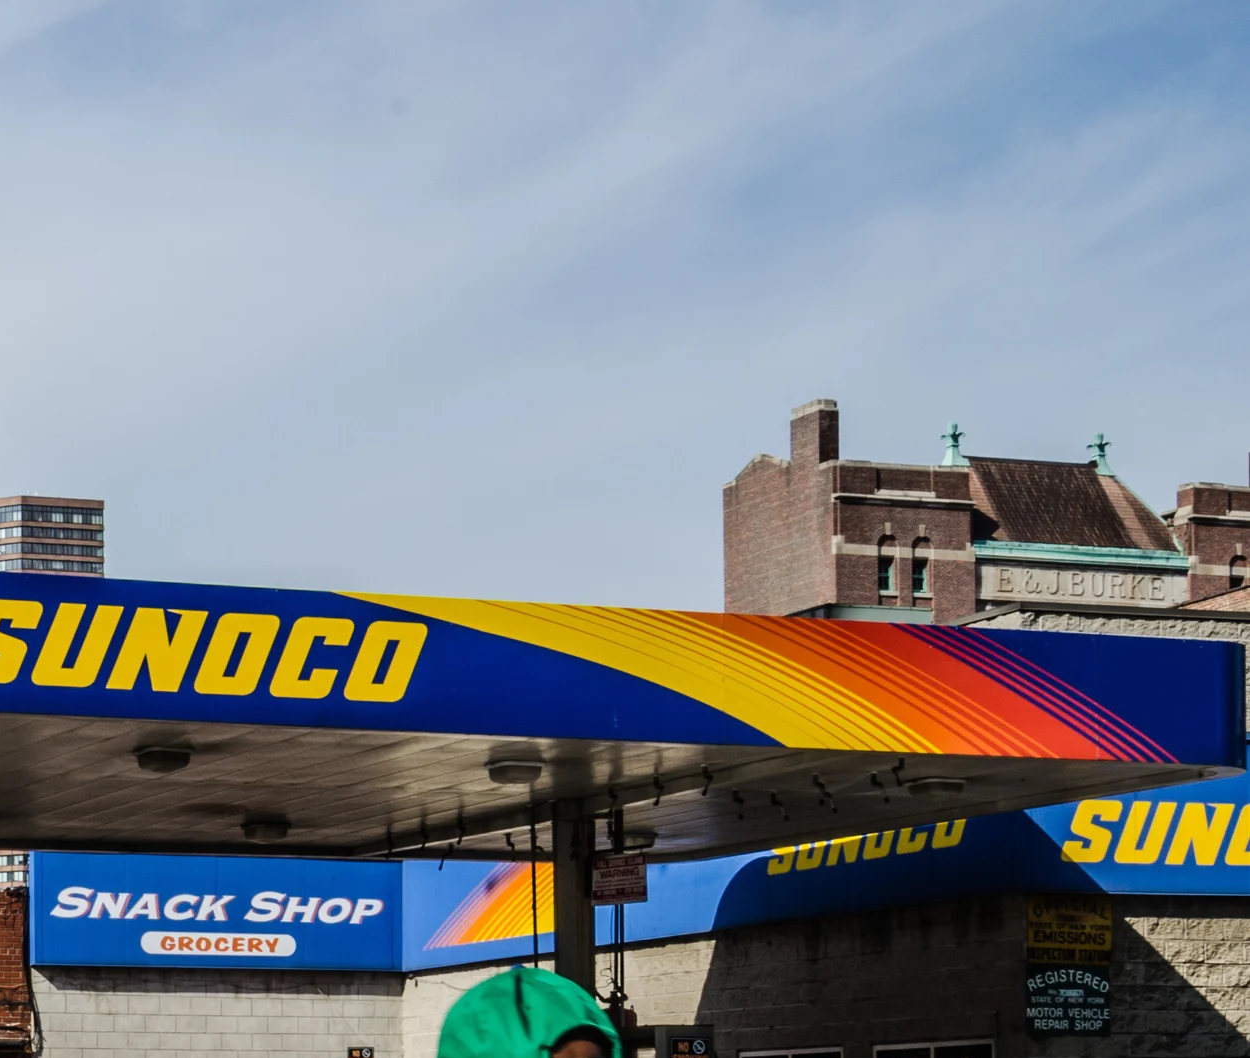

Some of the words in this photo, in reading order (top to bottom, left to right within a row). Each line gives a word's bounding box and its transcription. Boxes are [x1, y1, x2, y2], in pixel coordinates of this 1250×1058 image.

[50, 886, 236, 921] SNACK
[244, 891, 384, 924] SHOP
[160, 935, 279, 953] GROCERY
[1034, 930, 1106, 945] EMISSIONS
[1027, 969, 1109, 992] REGISTERED
[1031, 996, 1052, 1004] STATE
[1055, 996, 1066, 1004] OF
[1026, 1008, 1063, 1018] MOTOR
[1068, 1008, 1110, 1019] VEHICLE
[1034, 1020, 1069, 1030] REPAIR
[1074, 1020, 1103, 1030] SHOP
[678, 1042, 690, 1052] NO
